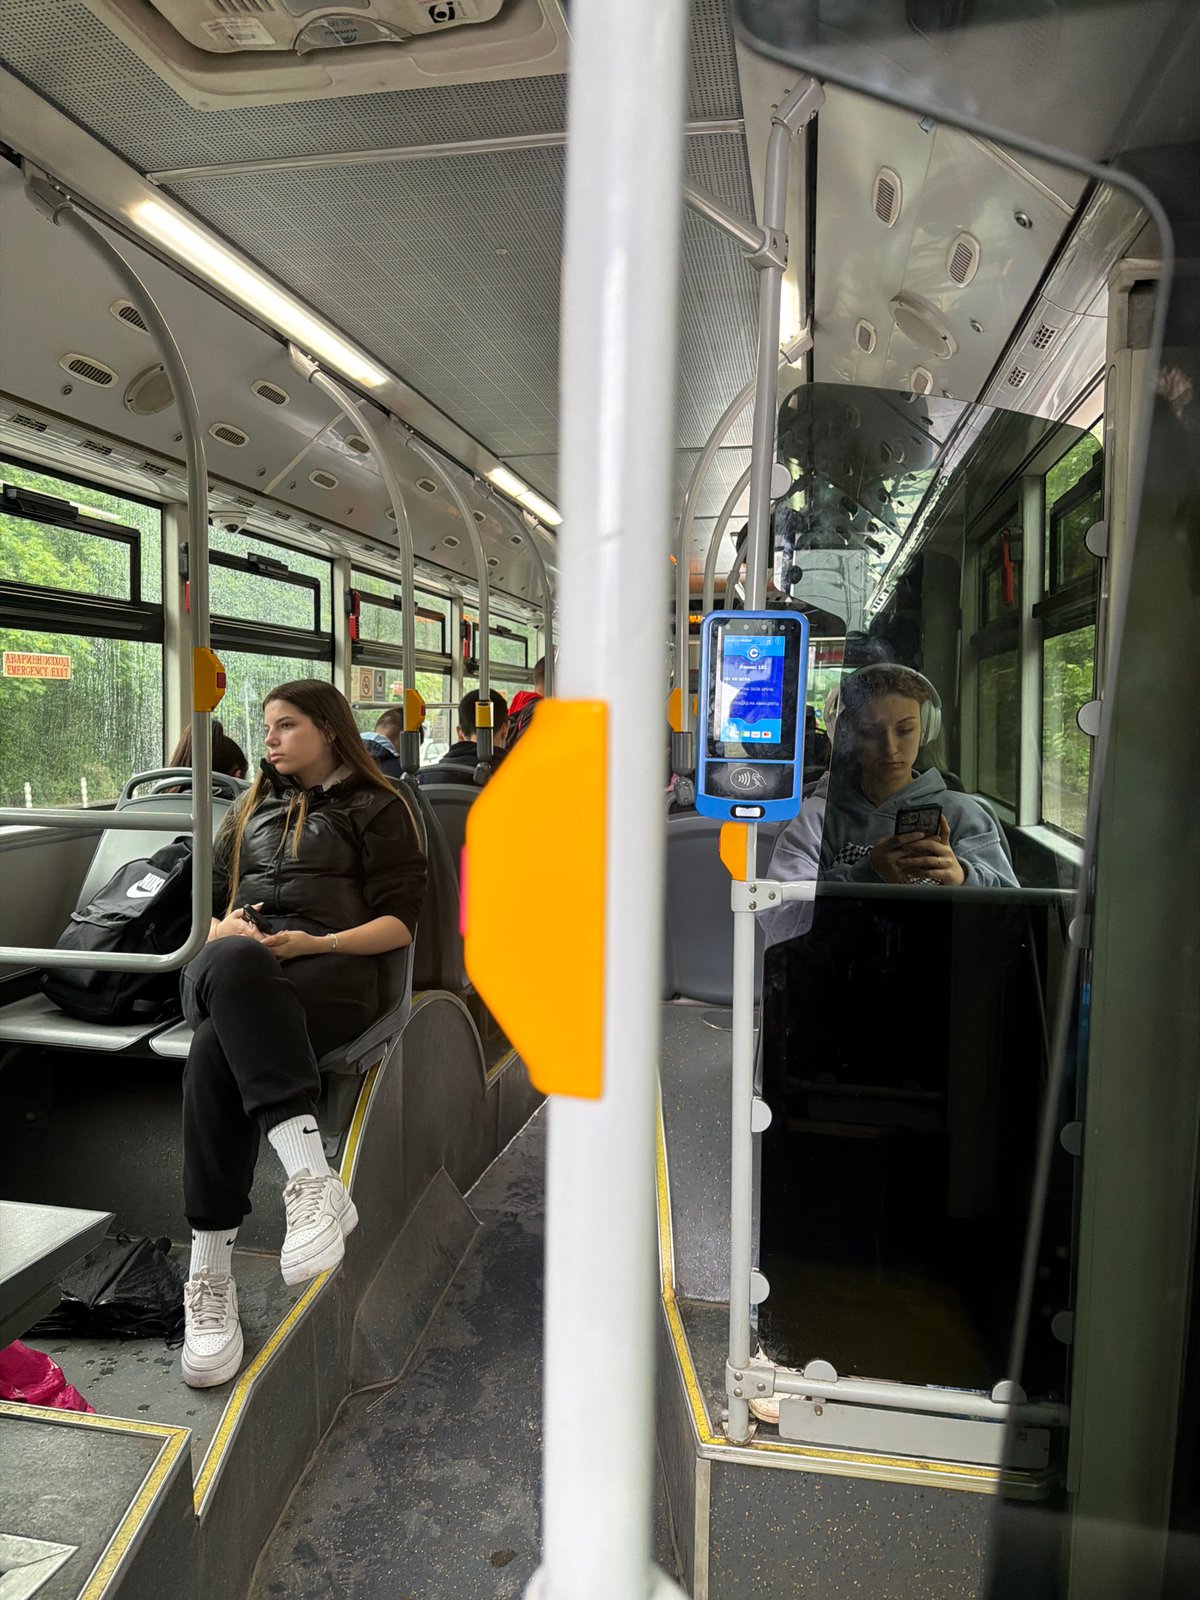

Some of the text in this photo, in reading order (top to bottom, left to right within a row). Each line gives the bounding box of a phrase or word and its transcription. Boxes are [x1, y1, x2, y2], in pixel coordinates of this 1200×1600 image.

[5, 653, 70, 668] АВАРИЕН ИЗХОД
[7, 665, 69, 678] EMERGENCY EXIT
